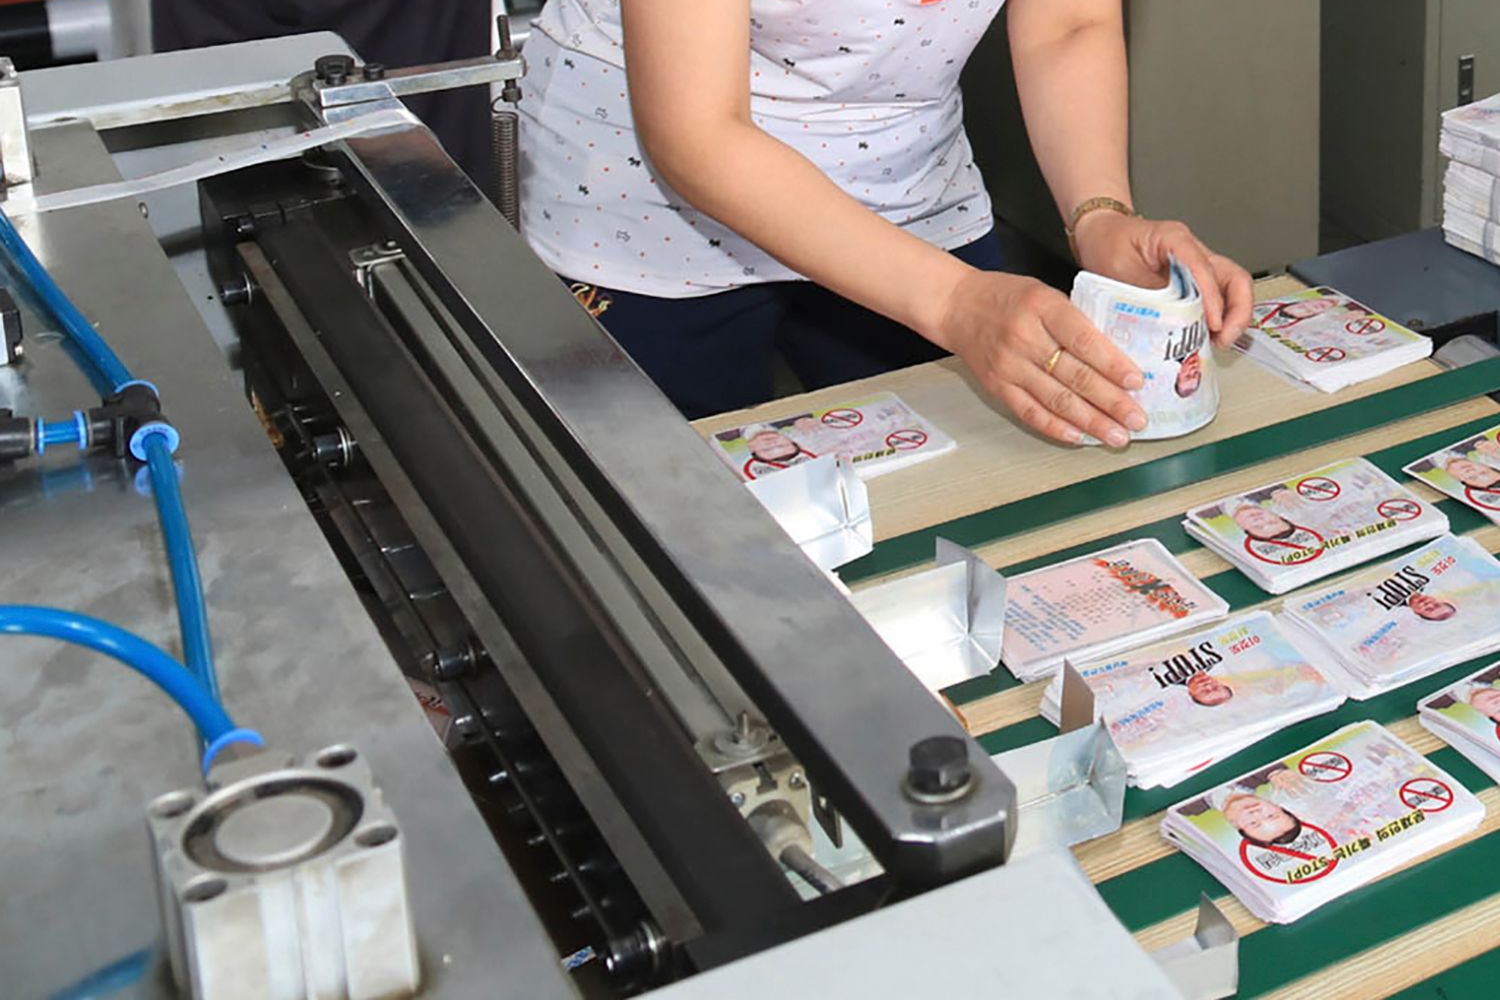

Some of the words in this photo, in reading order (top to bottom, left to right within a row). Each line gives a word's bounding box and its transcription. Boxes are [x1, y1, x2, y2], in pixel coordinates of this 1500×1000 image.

[1366, 565, 1430, 611] STOP!
[1148, 641, 1223, 689] STOP!
[1375, 809, 1426, 842] 문재인의
[1286, 856, 1329, 885] STOP!
